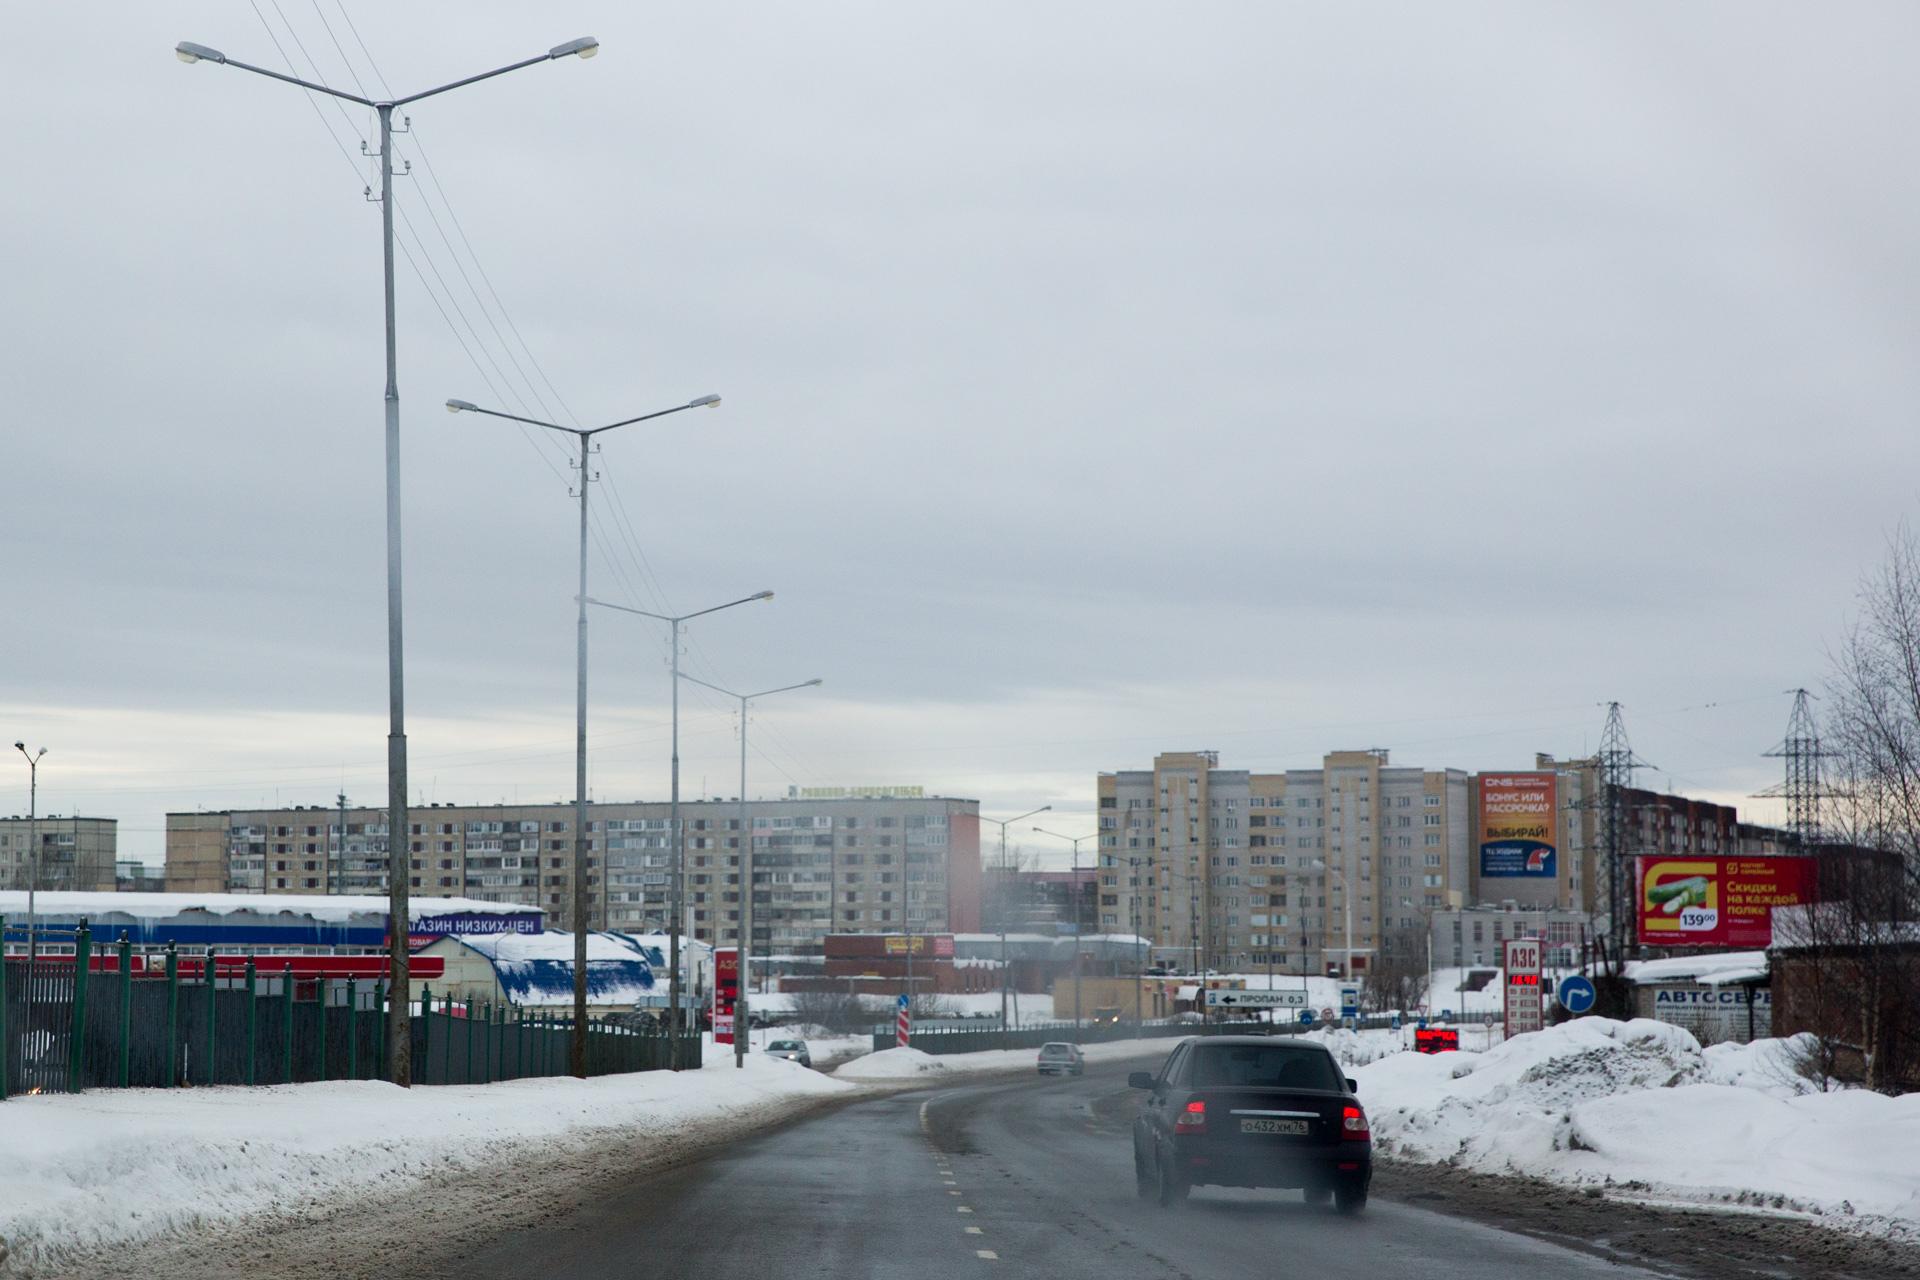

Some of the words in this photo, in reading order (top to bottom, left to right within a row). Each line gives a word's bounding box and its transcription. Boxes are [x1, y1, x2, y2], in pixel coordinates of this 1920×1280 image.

[1485, 792, 1519, 802] БОНУС
[1521, 791, 1545, 802] ИЛИ
[1485, 803, 1550, 814] РАССРОЧКА?
[1487, 824, 1549, 838] ВЫБИРАЙ!
[1727, 881, 1777, 894] Скидки
[1727, 895, 1743, 904] на
[1745, 893, 1798, 906] каждой
[1727, 906, 1766, 916] полке
[455, 921, 504, 932] НИЗКИХ
[1511, 948, 1536, 968] АЗС
[1240, 994, 1283, 1004] ПРОПАН
[1288, 995, 1304, 1005] 0,3
